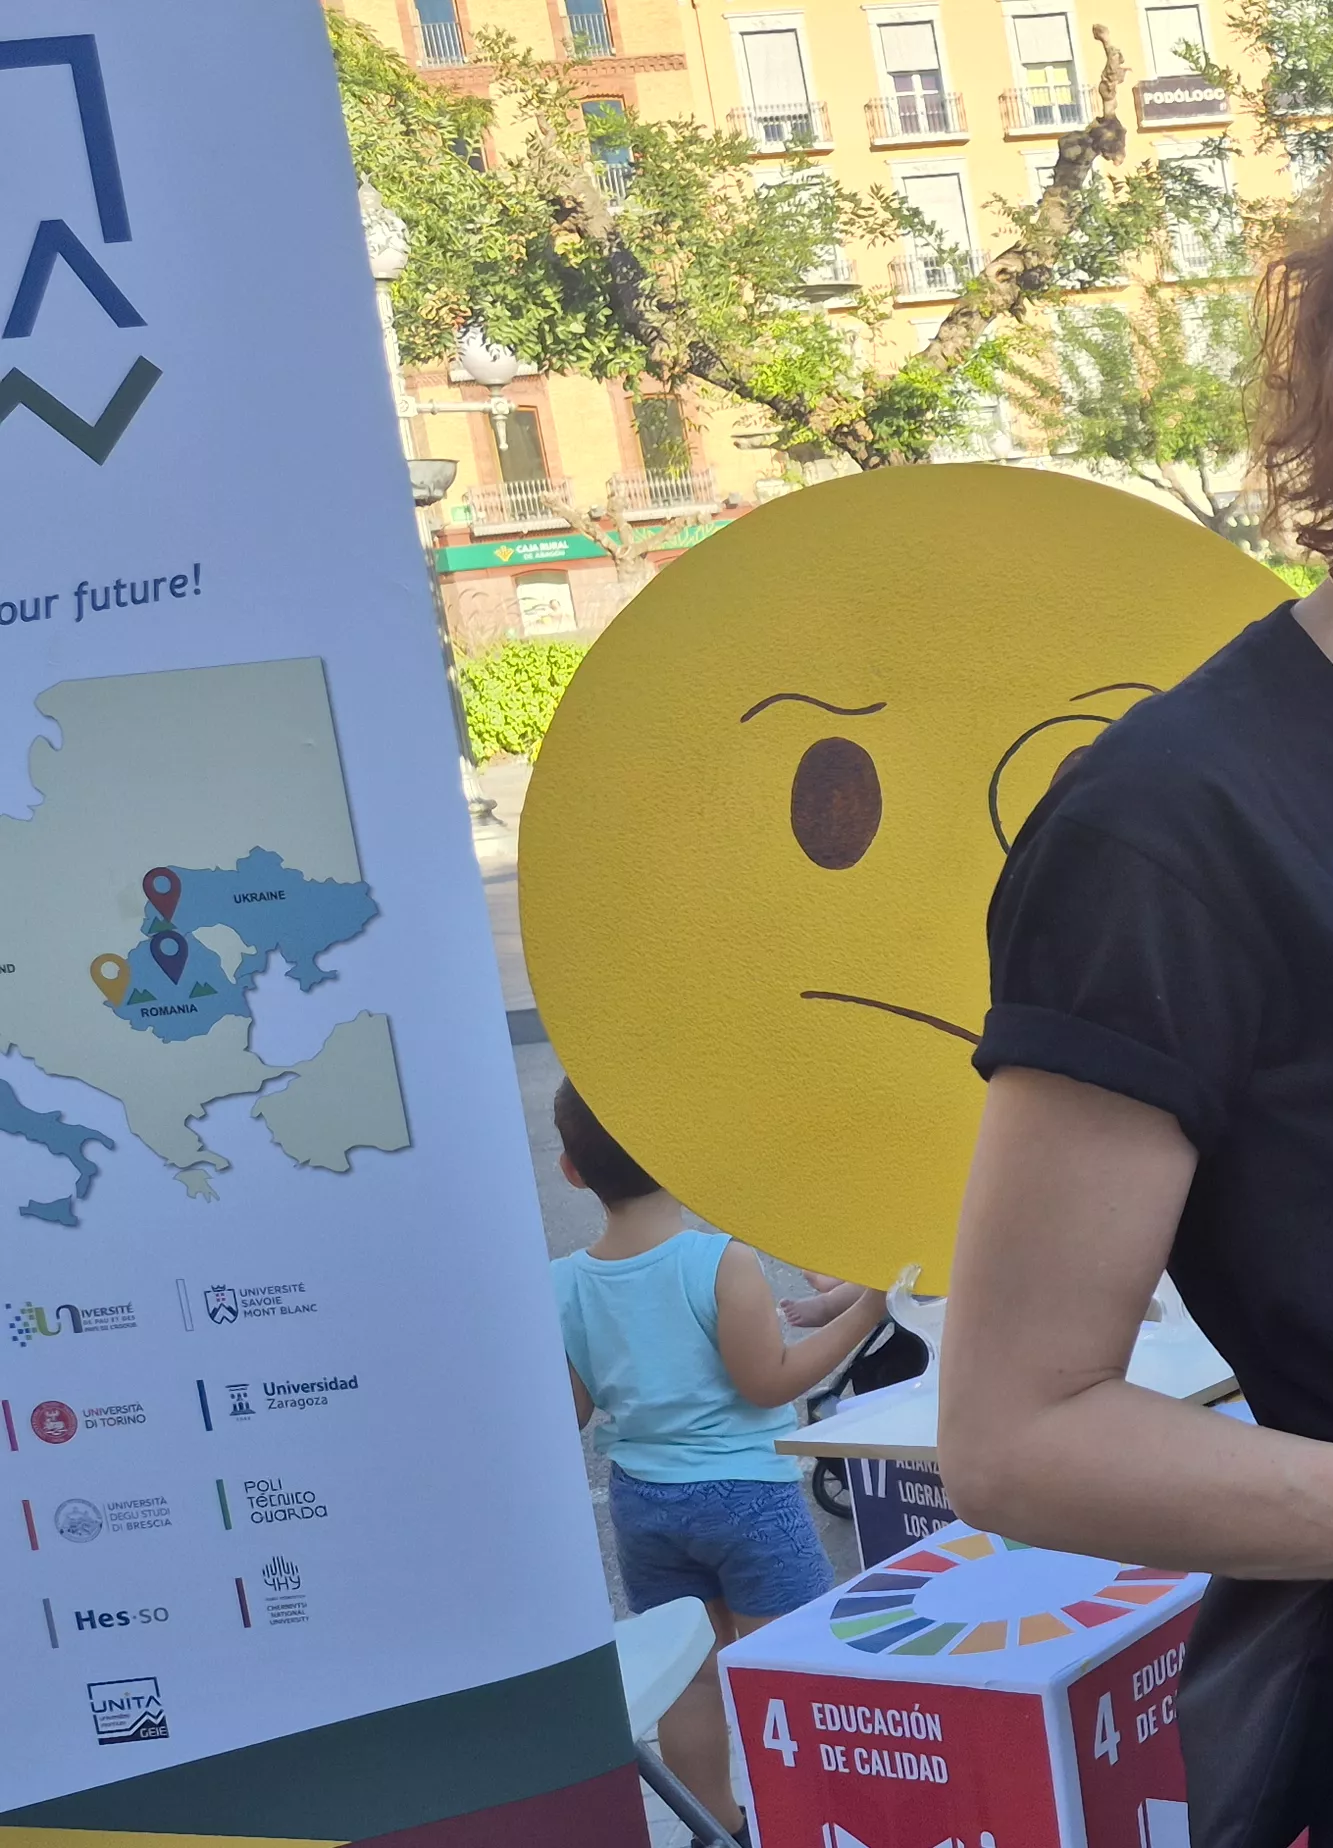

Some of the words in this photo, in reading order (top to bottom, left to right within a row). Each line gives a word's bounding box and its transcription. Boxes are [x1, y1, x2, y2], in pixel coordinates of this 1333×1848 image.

[1143, 87, 1226, 105] PODÓLOGO
[516, 544, 540, 553] CAJA
[540, 541, 569, 550] RURAL
[74, 562, 202, 623] future!
[233, 890, 287, 904] UKRAINE
[140, 1004, 198, 1018] ROMANIA
[239, 1282, 306, 1298] UNIVERSITÉ
[241, 1297, 283, 1308] SAVOIE
[243, 1307, 277, 1318] MONT
[280, 1304, 318, 1315] BLANC
[262, 1374, 359, 1397] Universidad
[266, 1396, 329, 1410] Zaragoza
[85, 1419, 98, 1429] DI
[100, 1414, 147, 1427] TORINO
[244, 1478, 283, 1494] POLI
[140, 1507, 171, 1518] STUDI
[112, 1523, 124, 1532] DI
[126, 1518, 173, 1531] BRESCIA
[903, 1512, 931, 1538] LOS
[1094, 1691, 1121, 1766] 4
[1136, 1704, 1159, 1744] DE
[140, 1726, 168, 1738] GEIE
[763, 1698, 799, 1768] 4
[812, 1703, 943, 1742] EDUCACIÓN
[819, 1743, 850, 1773] DE
[853, 1747, 949, 1784] CALIDAD
